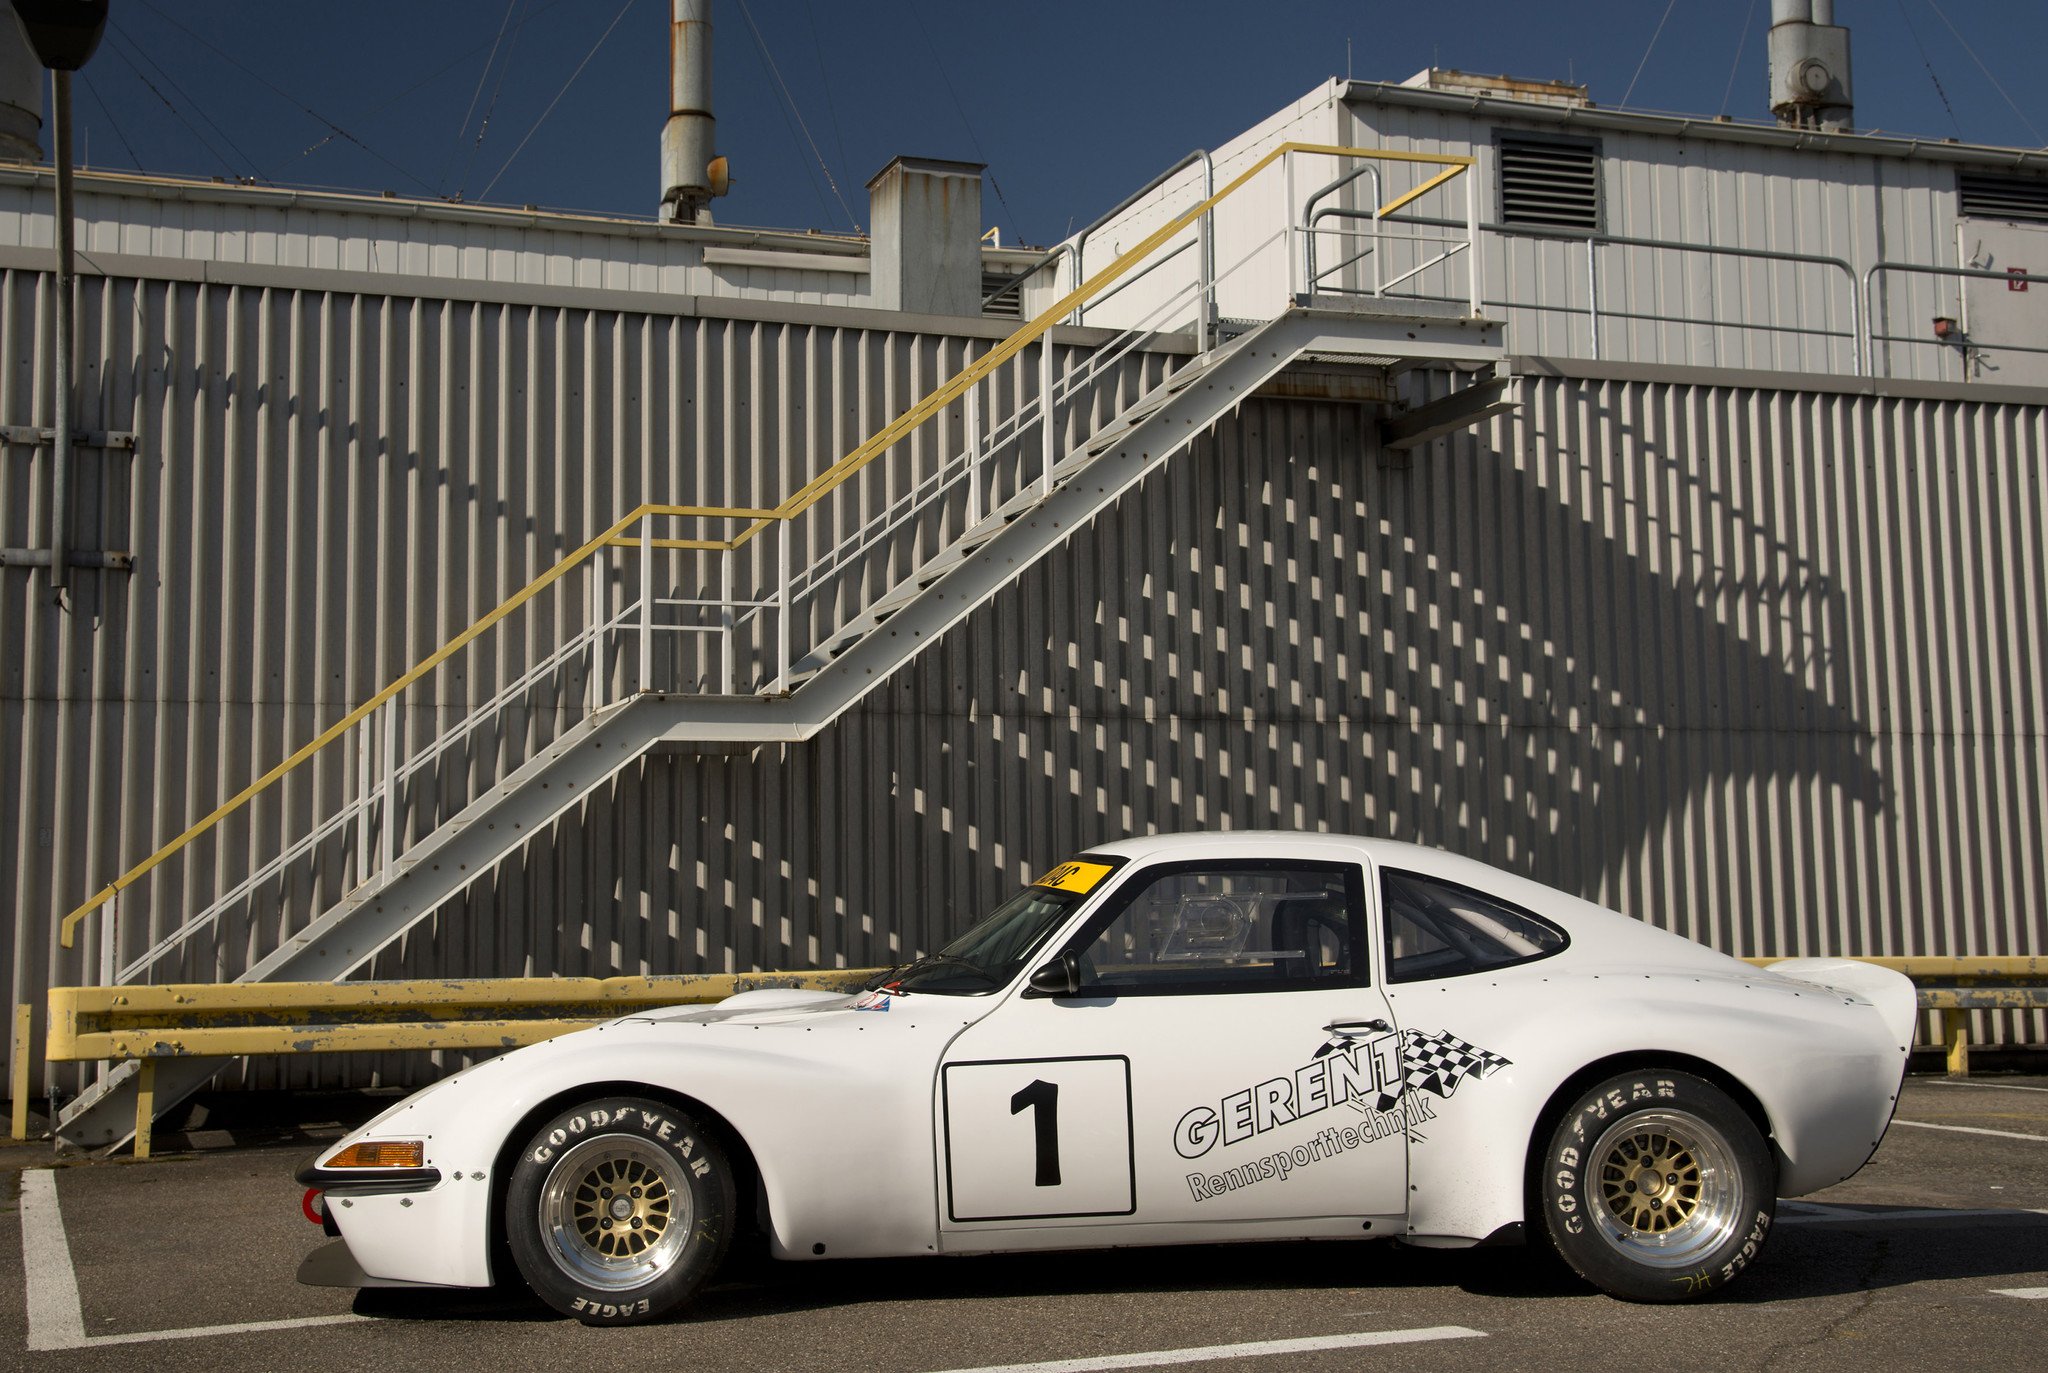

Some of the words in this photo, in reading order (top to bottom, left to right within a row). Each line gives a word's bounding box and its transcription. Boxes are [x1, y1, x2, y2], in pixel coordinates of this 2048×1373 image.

[1010, 1079, 1061, 1187] 1
[1173, 1032, 1408, 1159] GERENT
[1186, 1090, 1436, 1202] Rennsporttechnik
[1721, 1210, 1771, 1281] EAGLE
[571, 1297, 650, 1318] EAGLE
